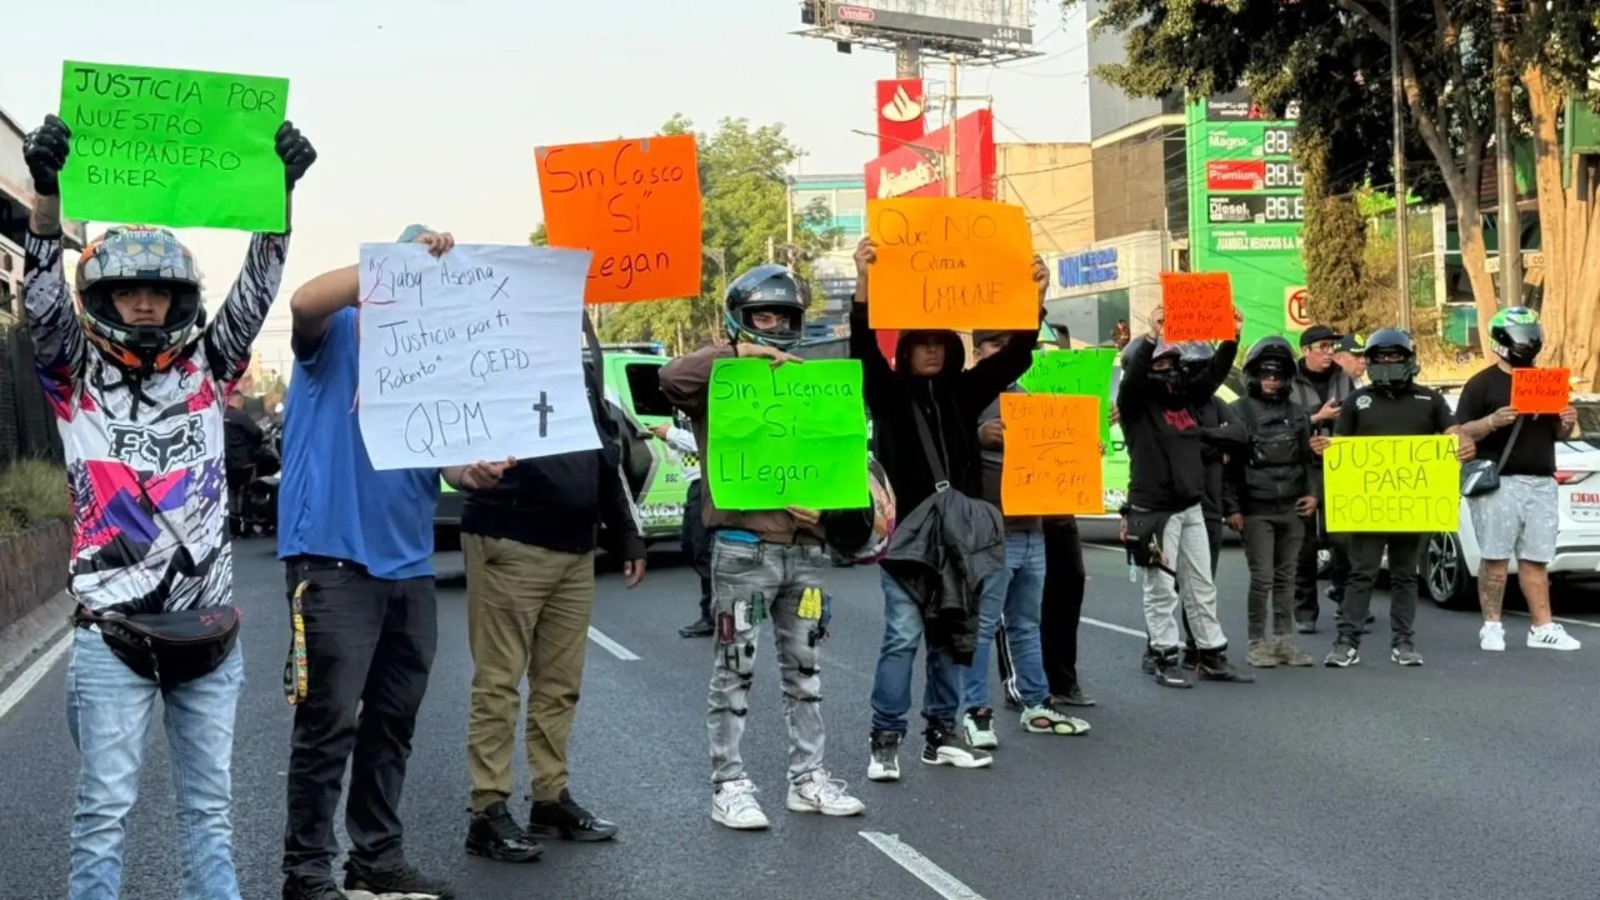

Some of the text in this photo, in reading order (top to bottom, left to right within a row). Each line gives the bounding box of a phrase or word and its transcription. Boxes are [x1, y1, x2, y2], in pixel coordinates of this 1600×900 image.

[74, 68, 277, 114] JUSTICIA POR
[76, 105, 203, 136] NUESTRO
[75, 134, 241, 172] COMPAÑERO
[1209, 135, 1248, 150] Magna
[87, 166, 166, 188] BIKER
[544, 143, 683, 193] Sin Casco
[1209, 170, 1260, 180] Premium
[1210, 203, 1248, 214] Diesel
[944, 214, 996, 241] NO
[923, 277, 1004, 313] IMPUNE
[377, 318, 456, 357] Justicia
[713, 363, 853, 400] Sin Licencia
[1328, 437, 1459, 471] JUSTICIA
[1363, 465, 1428, 494] PARA
[1332, 493, 1455, 526] ROBERTO
